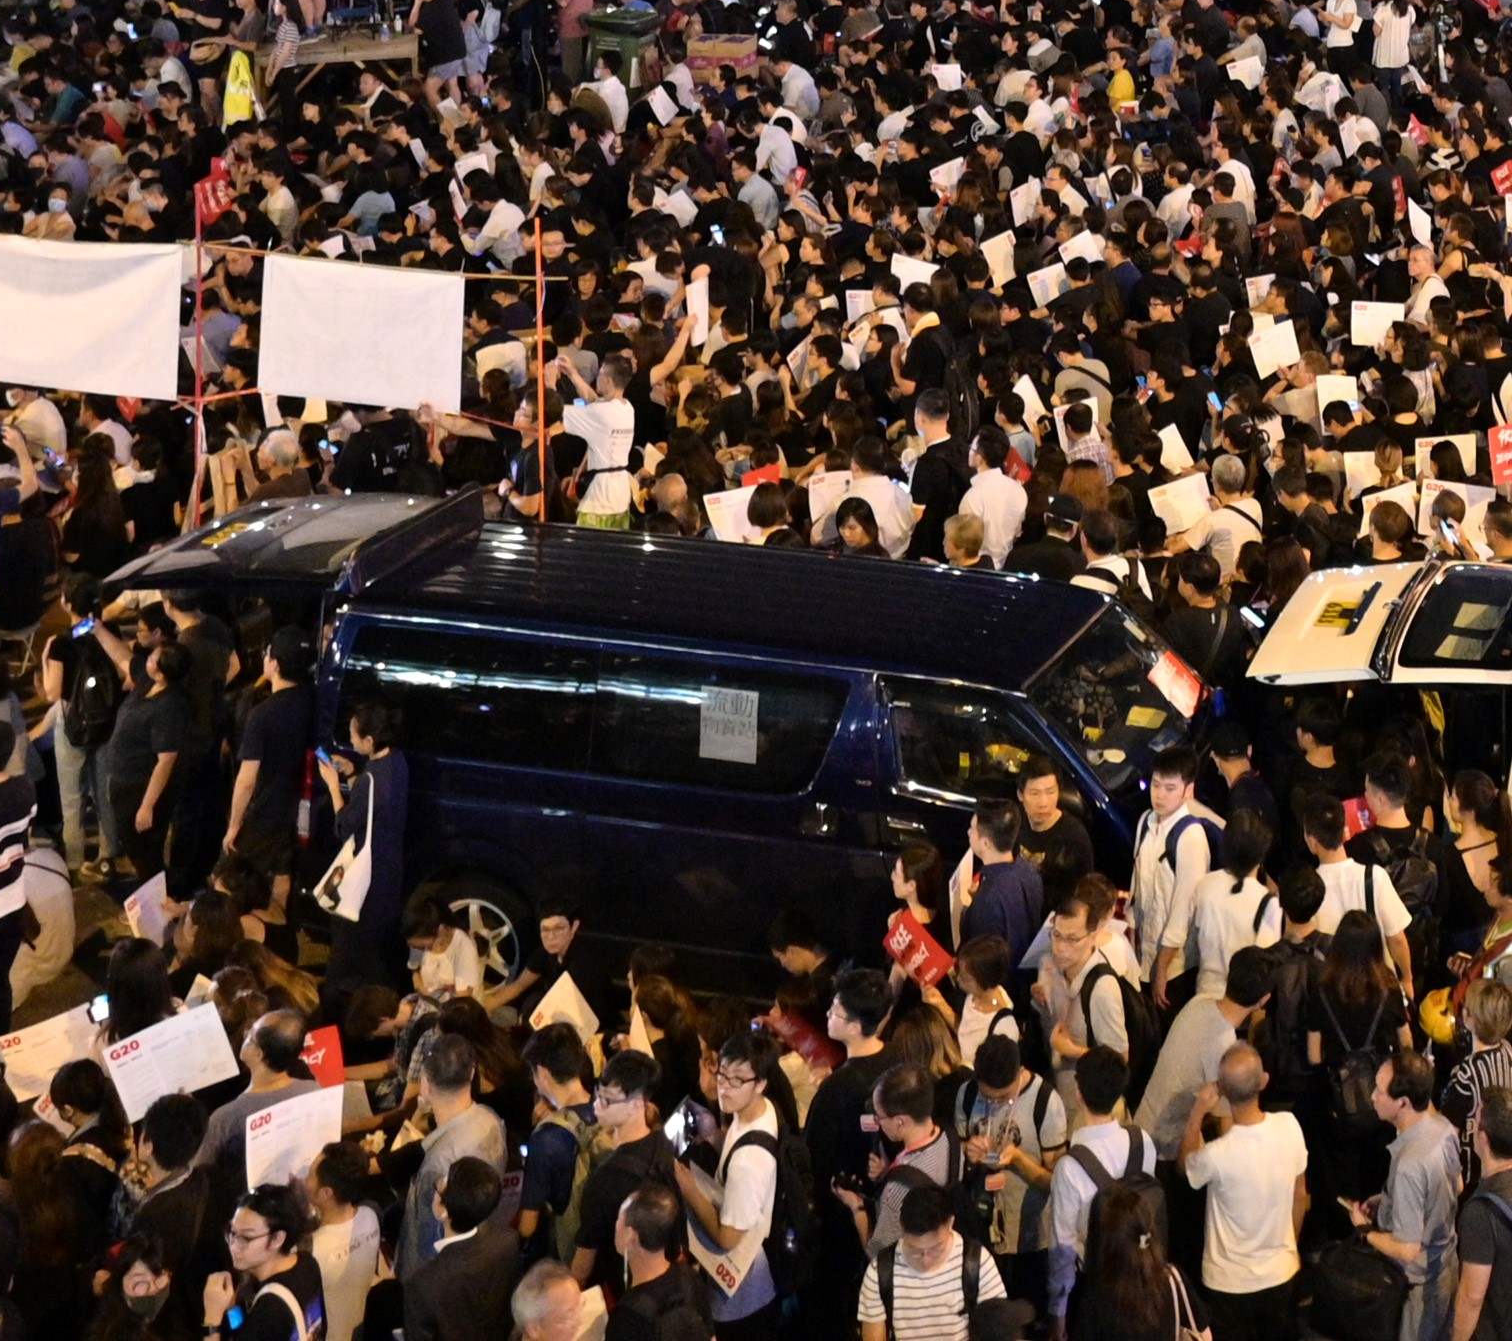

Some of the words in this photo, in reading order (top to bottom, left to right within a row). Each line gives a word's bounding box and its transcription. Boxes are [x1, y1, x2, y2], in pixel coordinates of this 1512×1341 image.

[705, 689, 754, 719] 流動
[110, 1040, 140, 1061] G20
[250, 1113, 272, 1130] G20
[715, 1262, 737, 1289] G20
